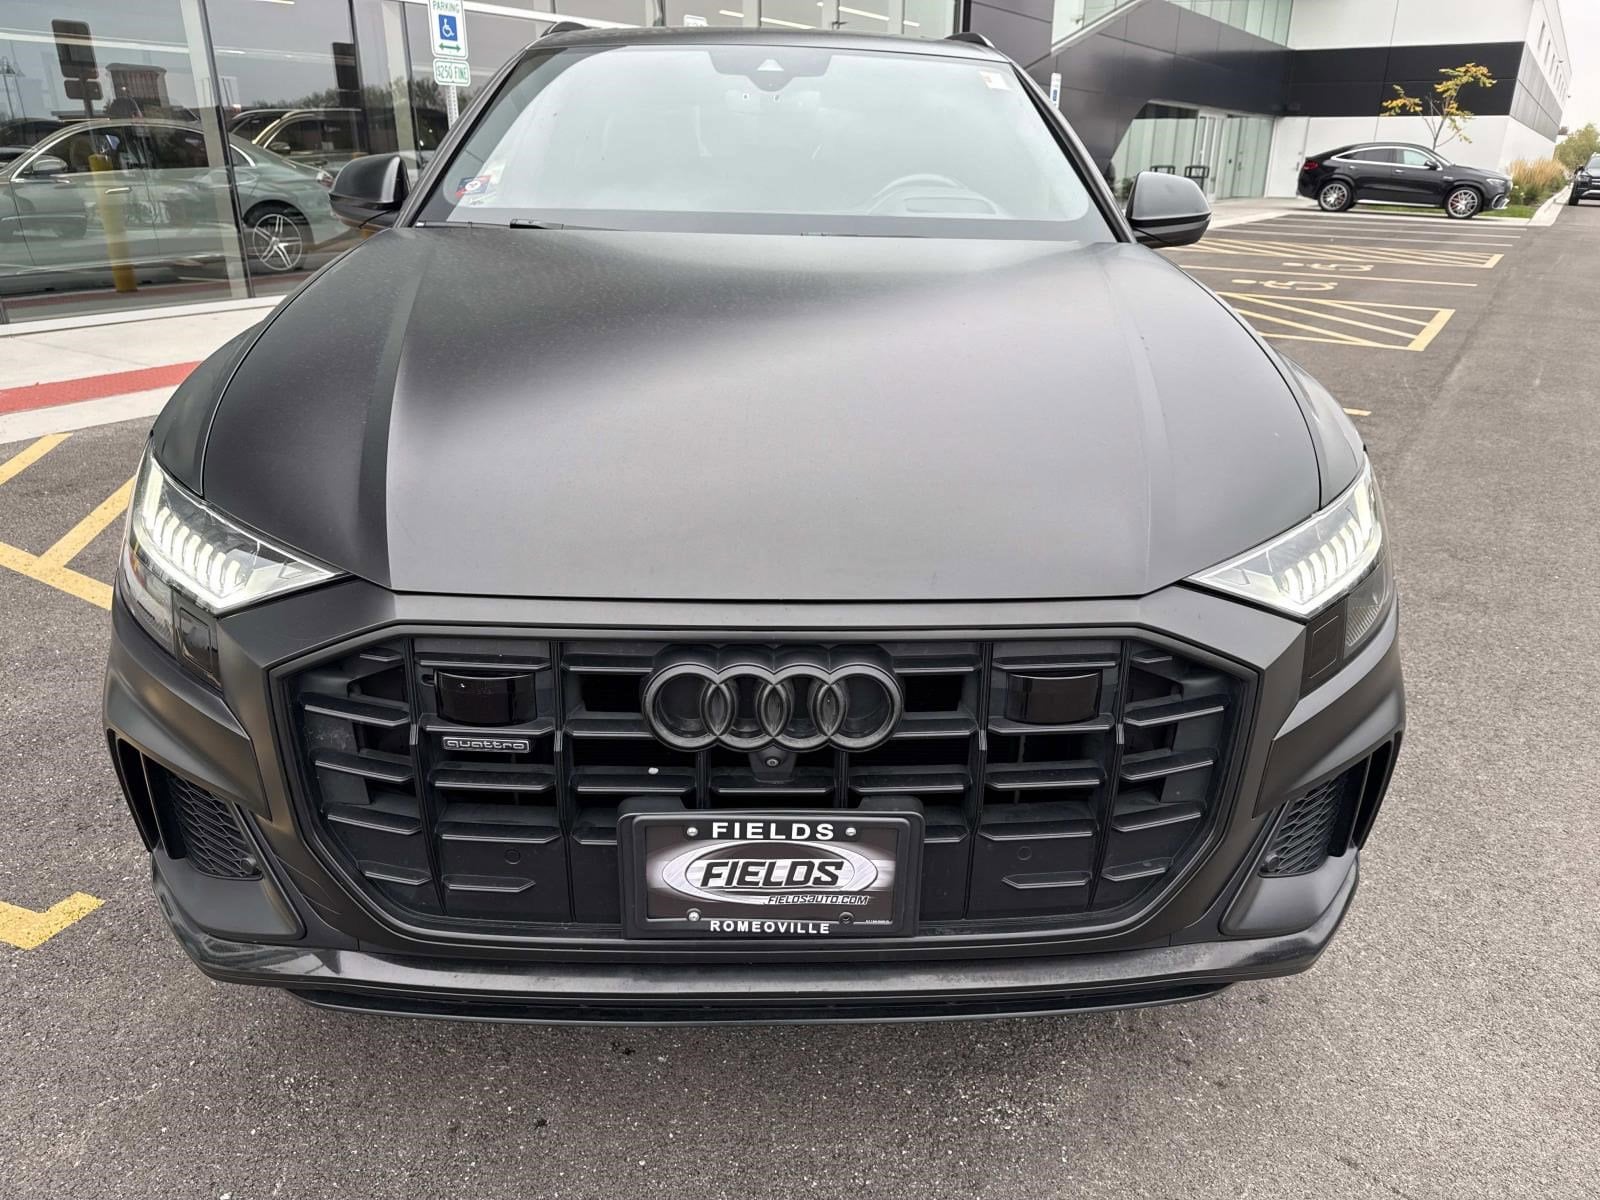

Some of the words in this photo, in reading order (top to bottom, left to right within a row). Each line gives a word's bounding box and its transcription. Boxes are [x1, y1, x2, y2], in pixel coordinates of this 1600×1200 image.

[447, 740, 525, 749] quattro
[712, 822, 834, 839] FIELDS
[700, 860, 845, 887] FIELDS
[710, 920, 830, 934] ROMEOVILLE
